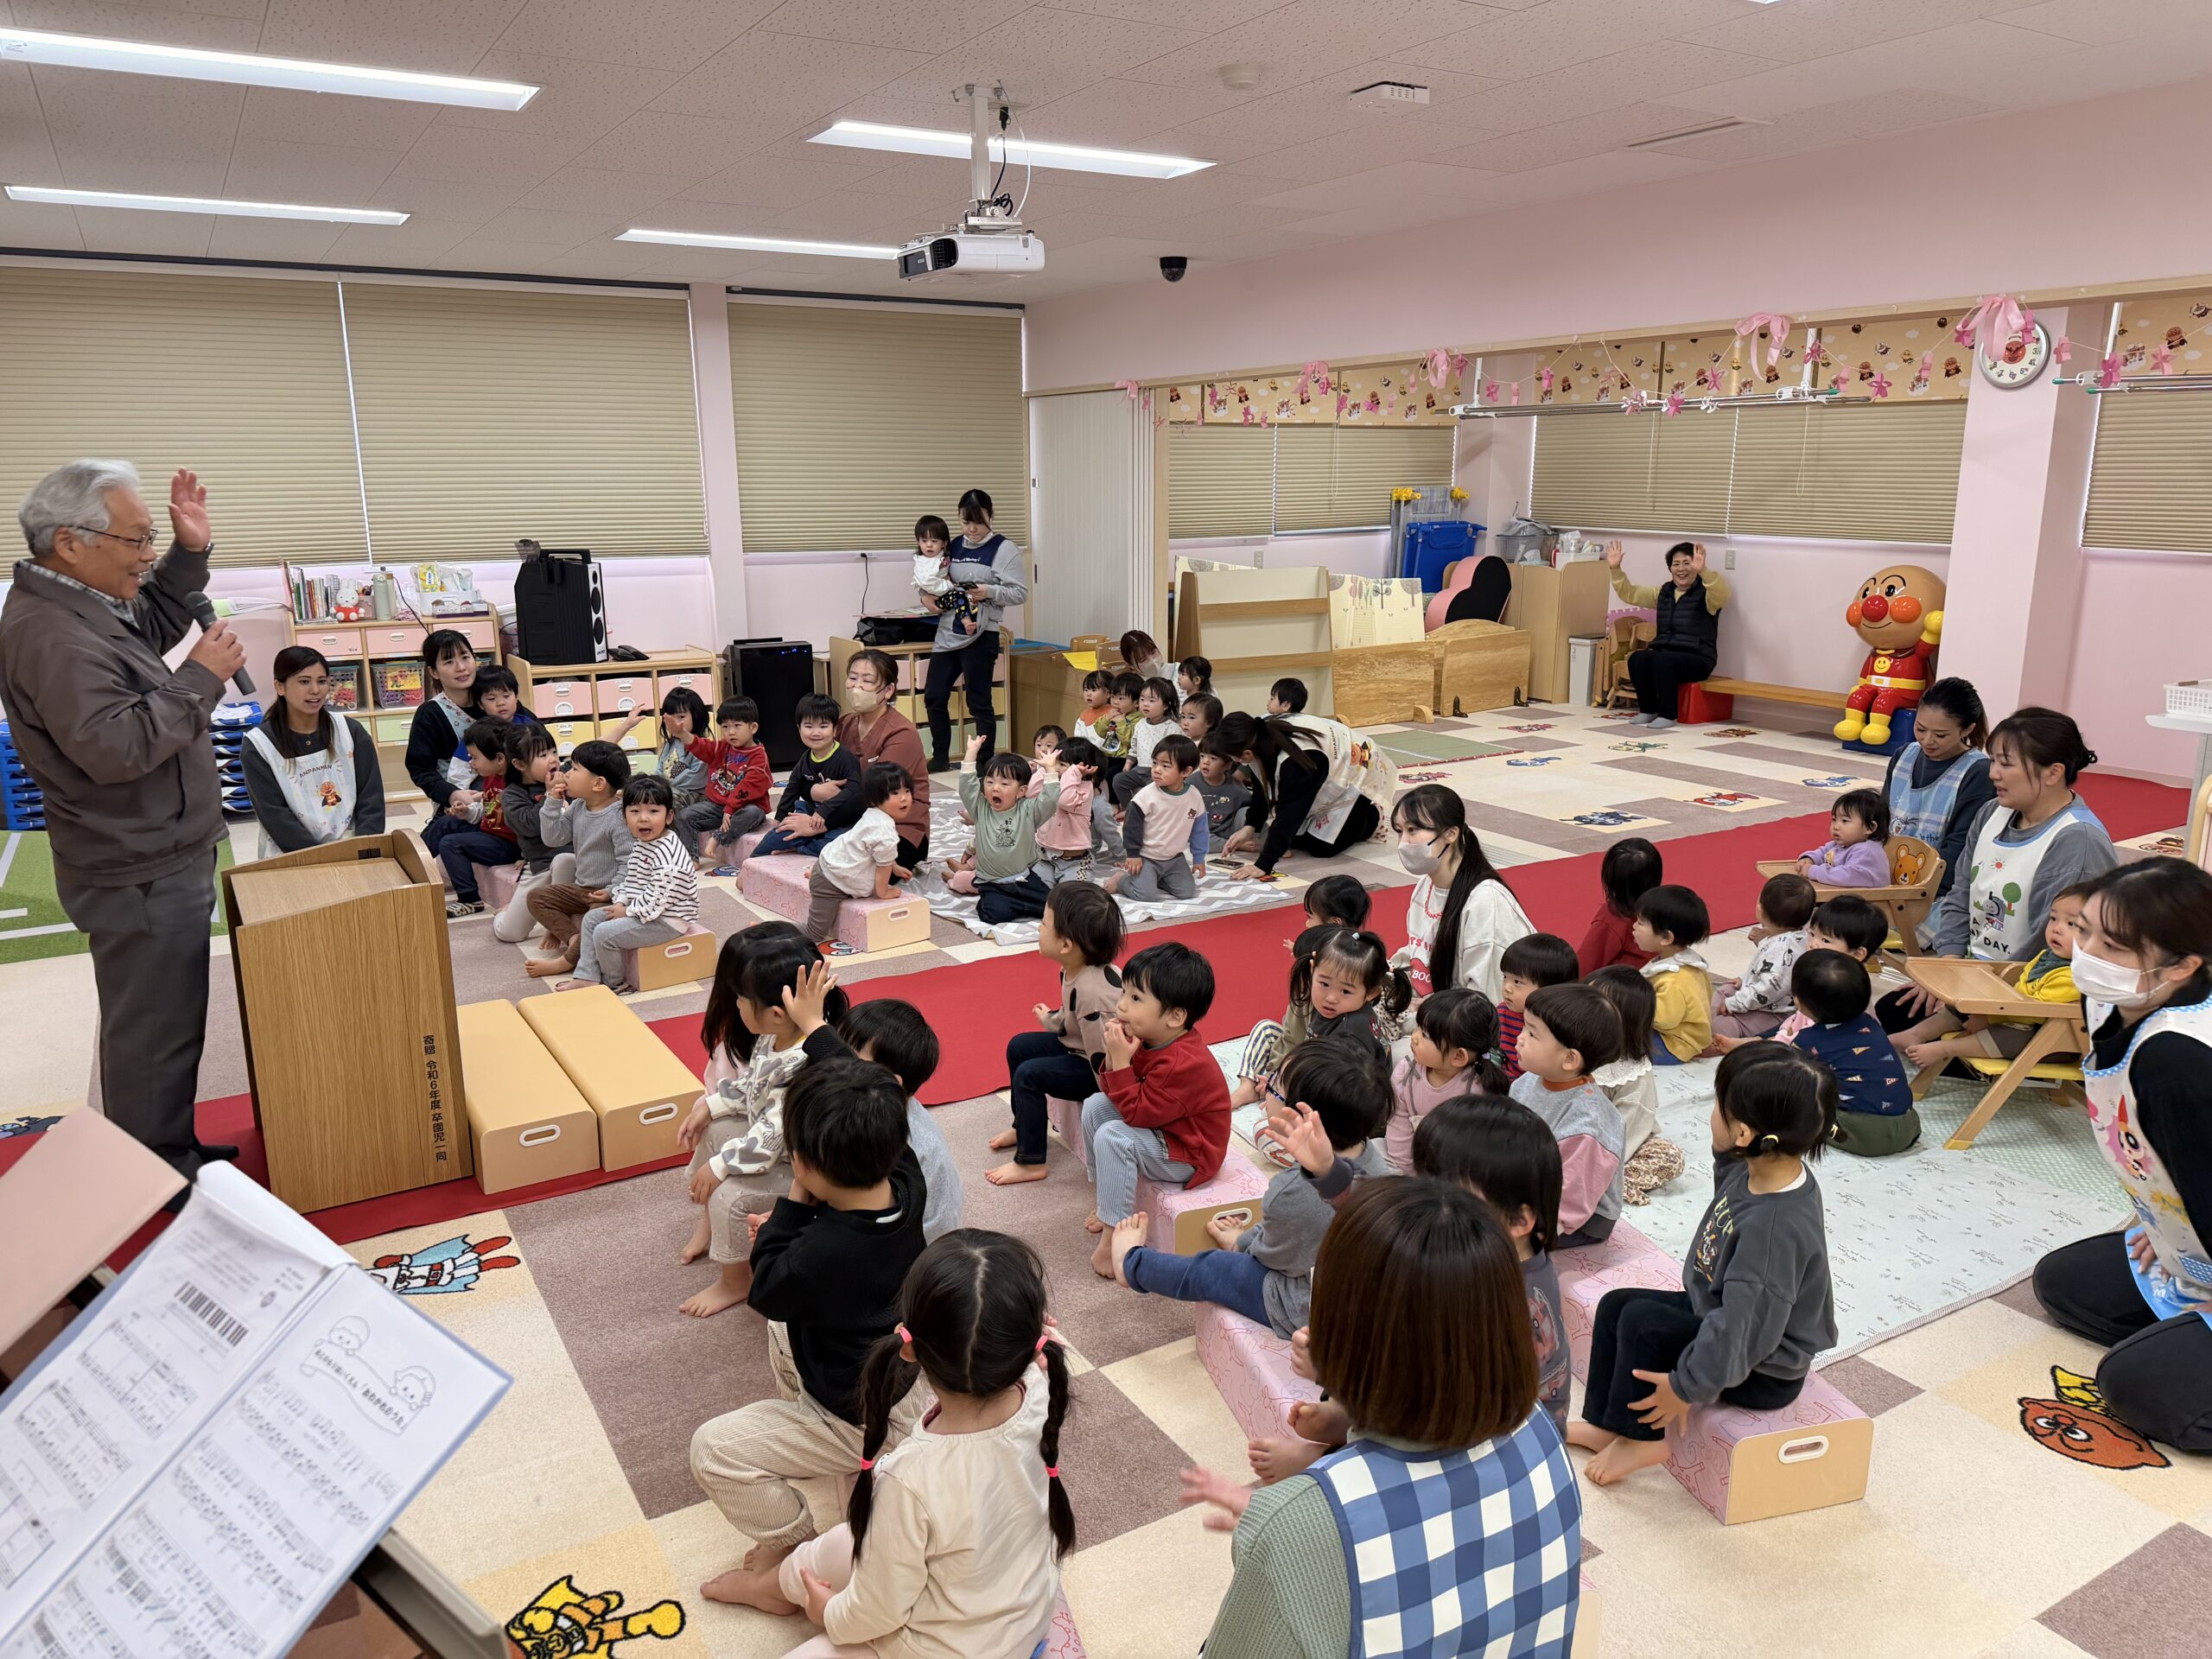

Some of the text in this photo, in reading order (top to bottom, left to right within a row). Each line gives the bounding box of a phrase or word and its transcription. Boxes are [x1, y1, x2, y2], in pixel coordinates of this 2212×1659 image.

[299, 764, 333, 779] ANPANMAN
[1983, 936, 2011, 955] DAY.
[423, 1034, 448, 1162] 寄贈 令和6年度 卒園児一同
